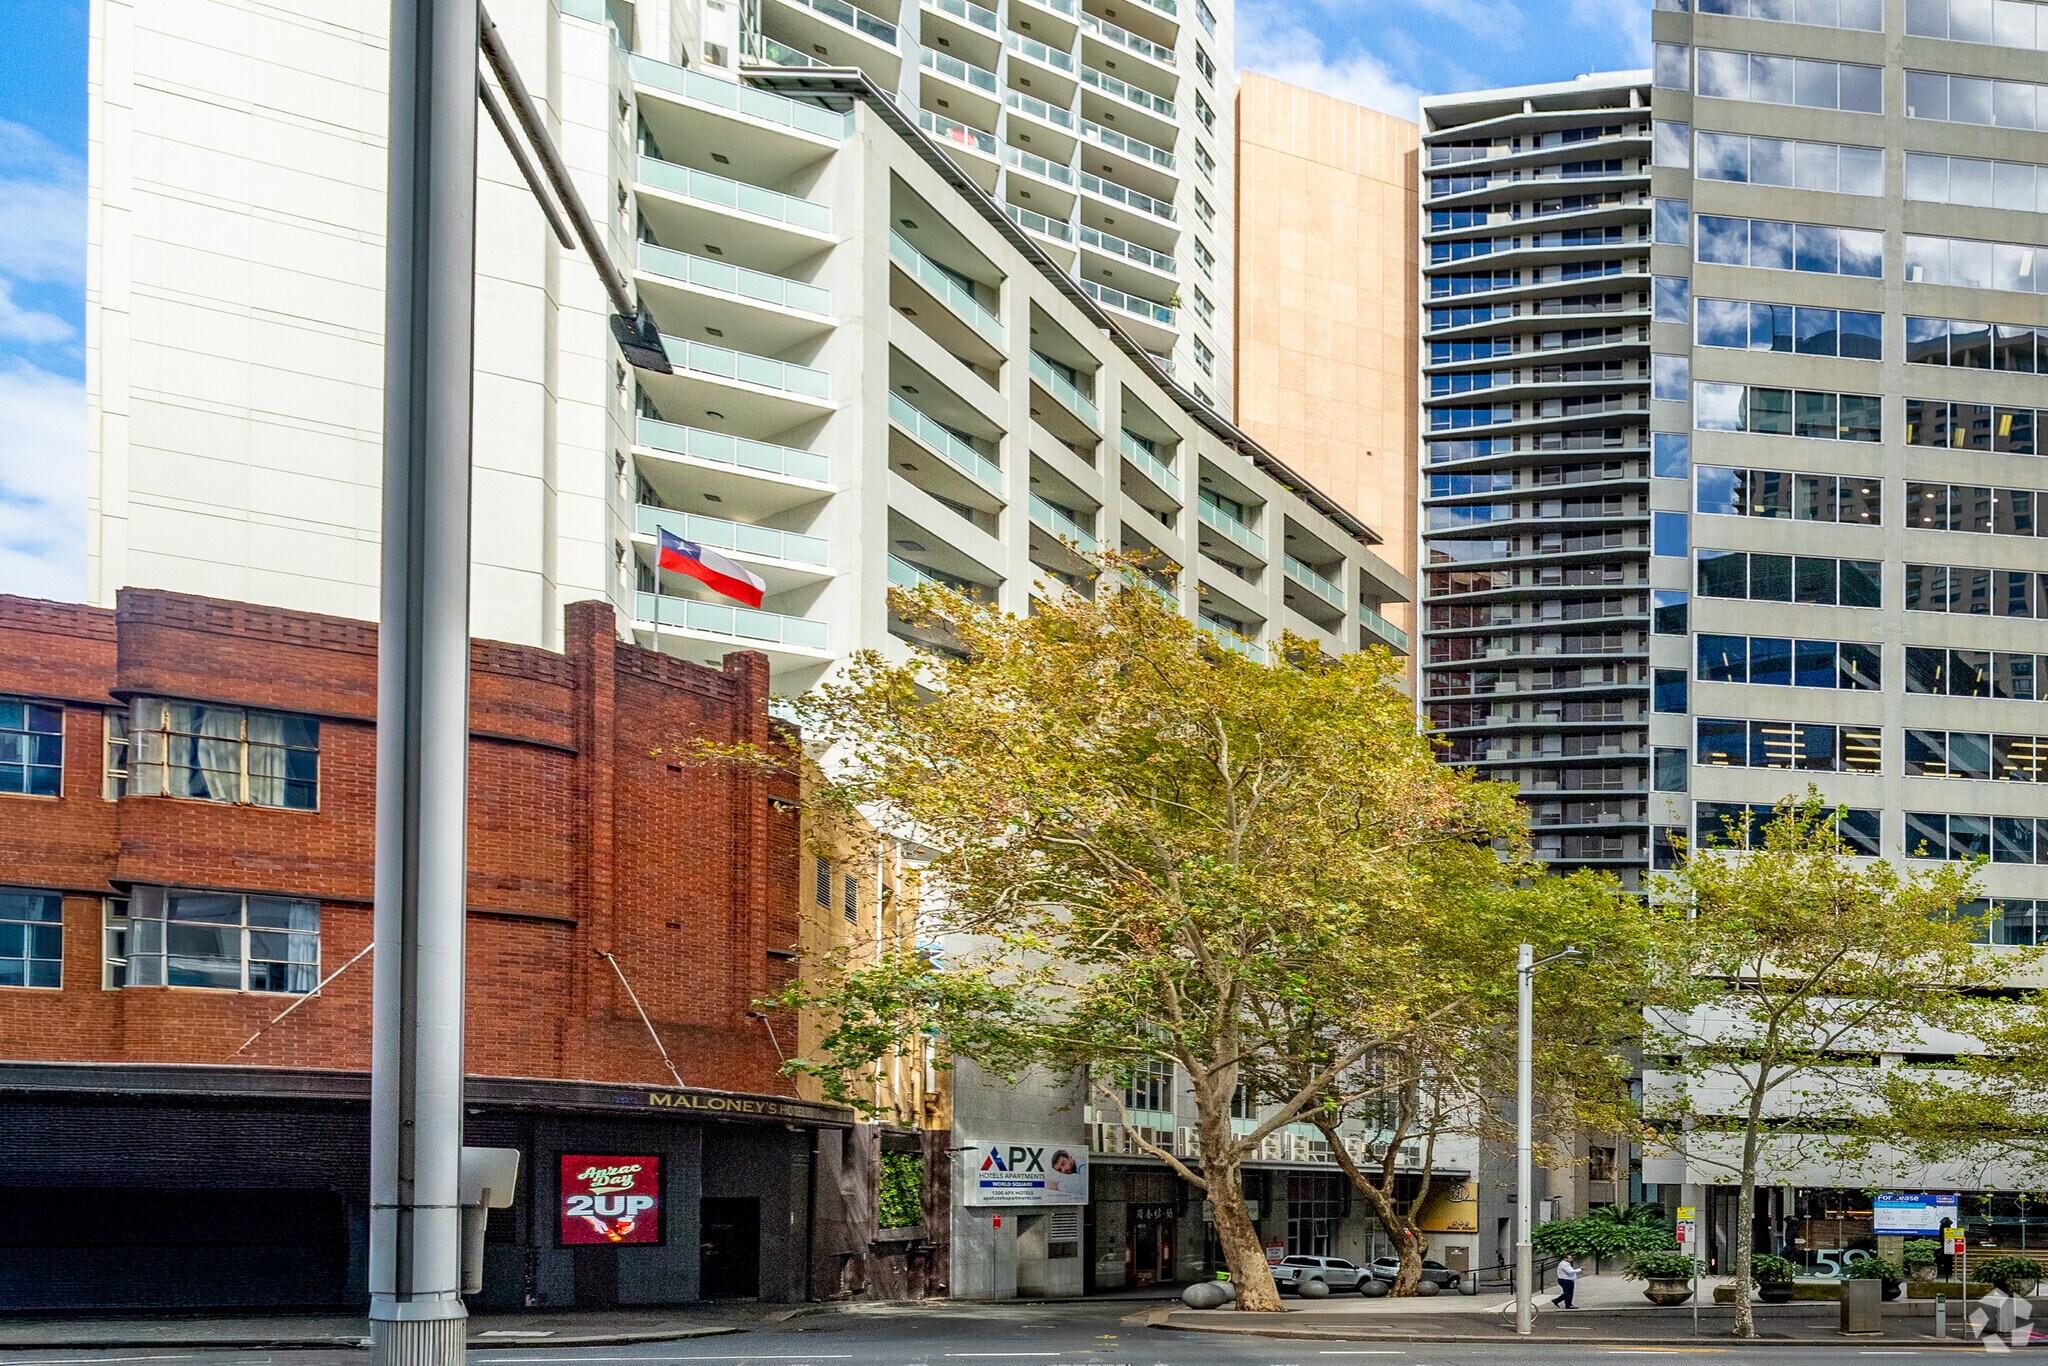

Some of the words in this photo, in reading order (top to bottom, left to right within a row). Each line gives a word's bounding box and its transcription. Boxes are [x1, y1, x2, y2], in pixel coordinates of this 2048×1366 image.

[649, 1093, 777, 1115] MALONEY'S
[980, 1146, 1045, 1172] APX
[577, 1164, 642, 1181] Anzac
[590, 1174, 635, 1190] Day
[566, 1195, 655, 1216] 2UP
